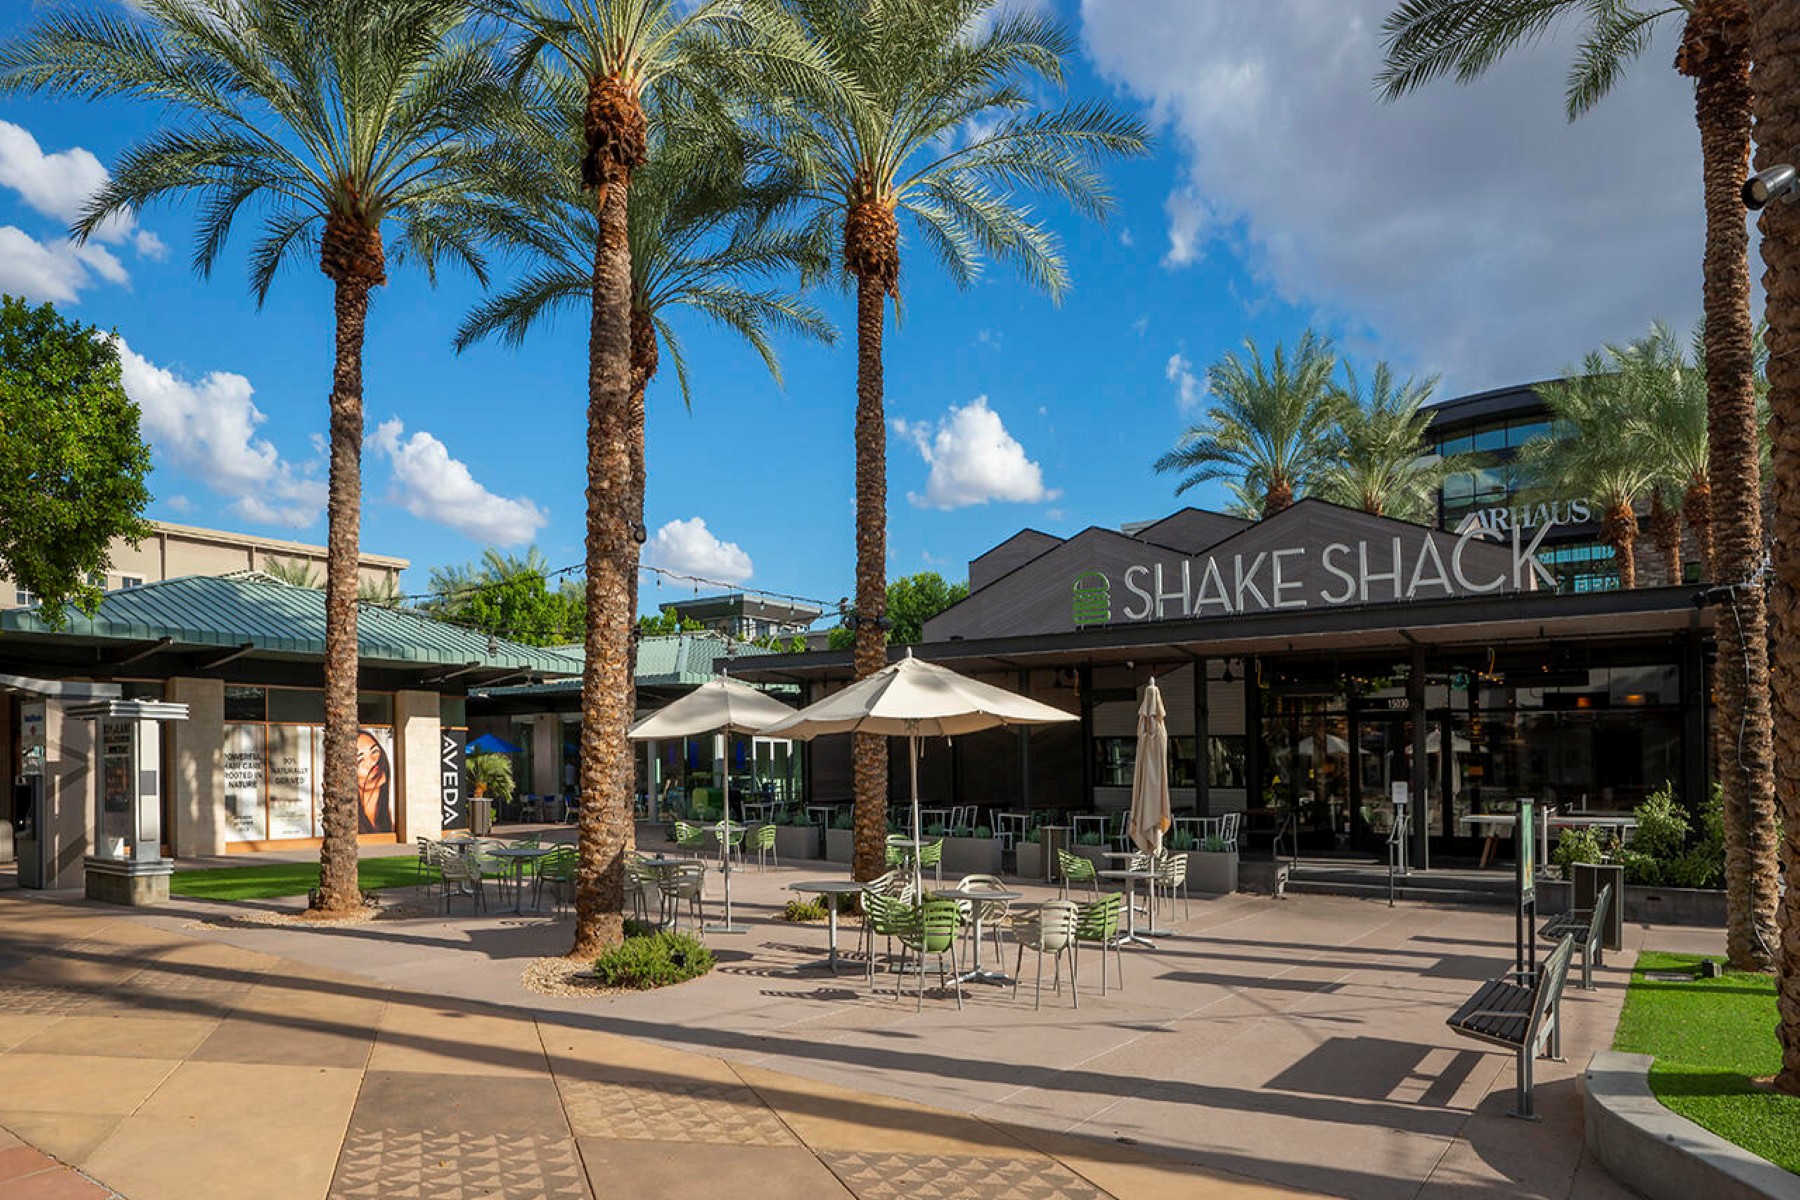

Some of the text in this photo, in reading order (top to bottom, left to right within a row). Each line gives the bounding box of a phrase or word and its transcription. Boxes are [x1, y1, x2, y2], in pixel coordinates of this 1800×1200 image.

[1123, 521, 1557, 621] SHAKE SHACK
[442, 734, 459, 825] AVEDA
